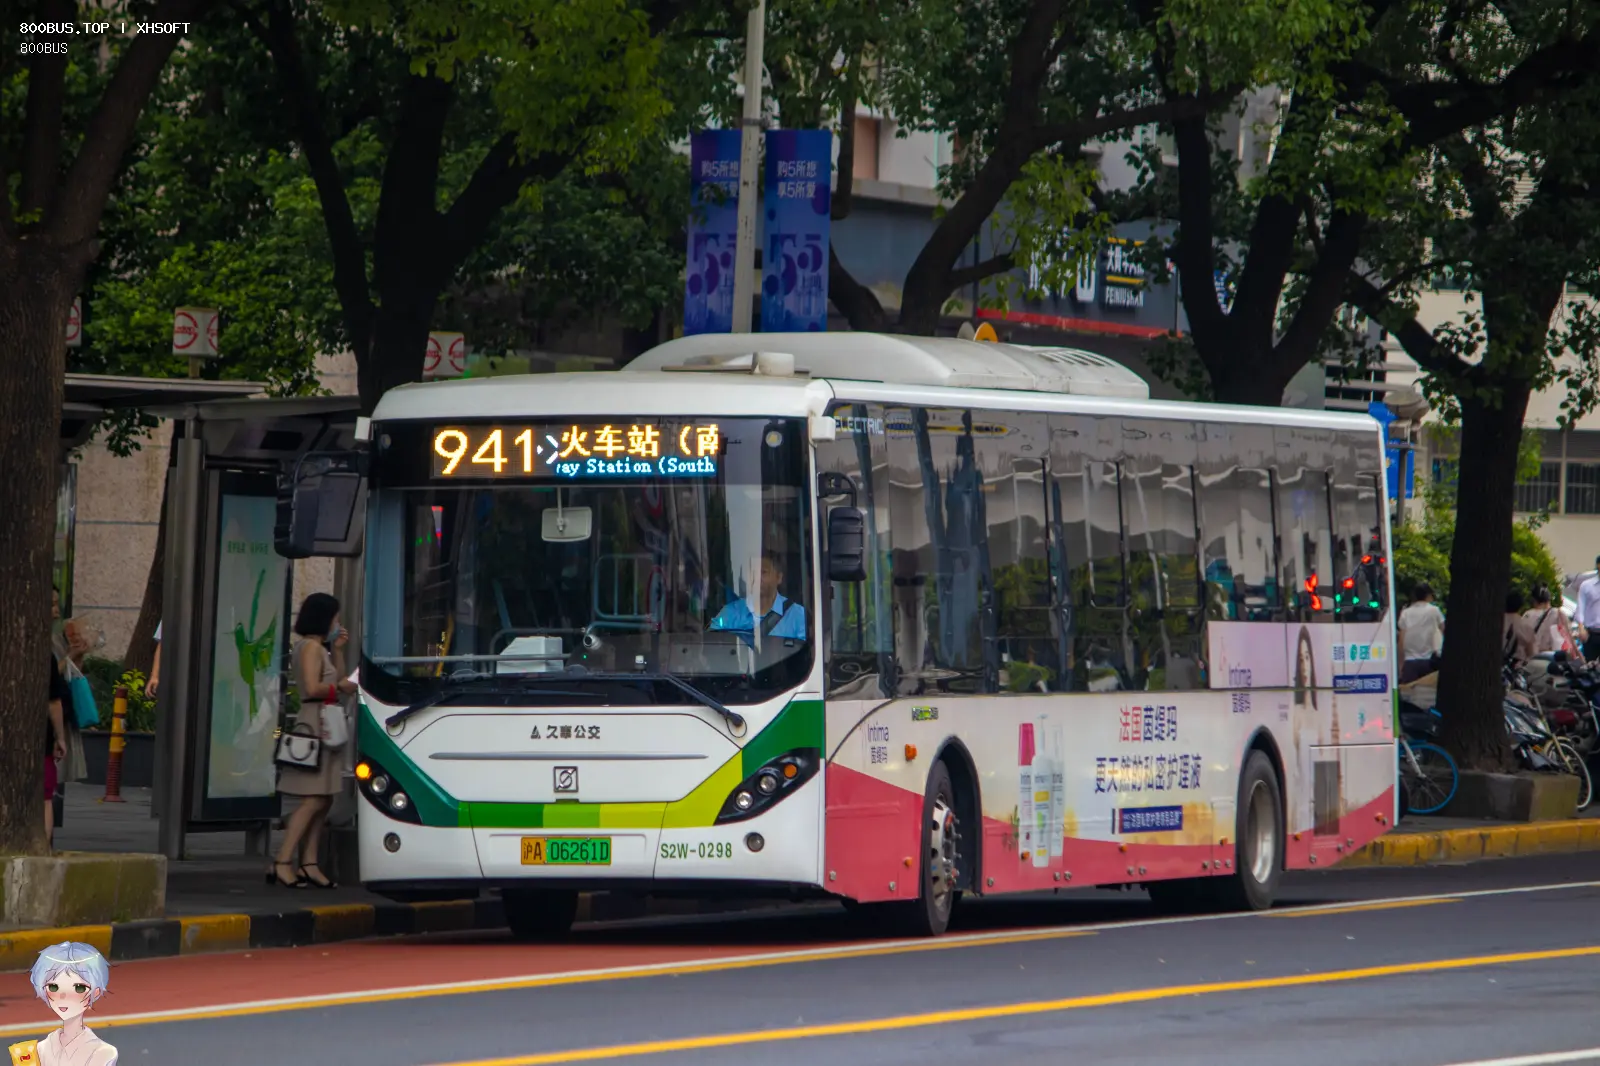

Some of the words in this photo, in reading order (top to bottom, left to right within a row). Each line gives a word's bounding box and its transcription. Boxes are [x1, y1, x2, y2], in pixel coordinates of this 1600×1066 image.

[434, 428, 533, 475] 941
[586, 458, 652, 474] Station
[658, 456, 716, 475] (South
[546, 725, 600, 739] 久事公交
[1095, 753, 1202, 793] 更天然的私密护理液
[660, 843, 732, 859] S2W-0298
